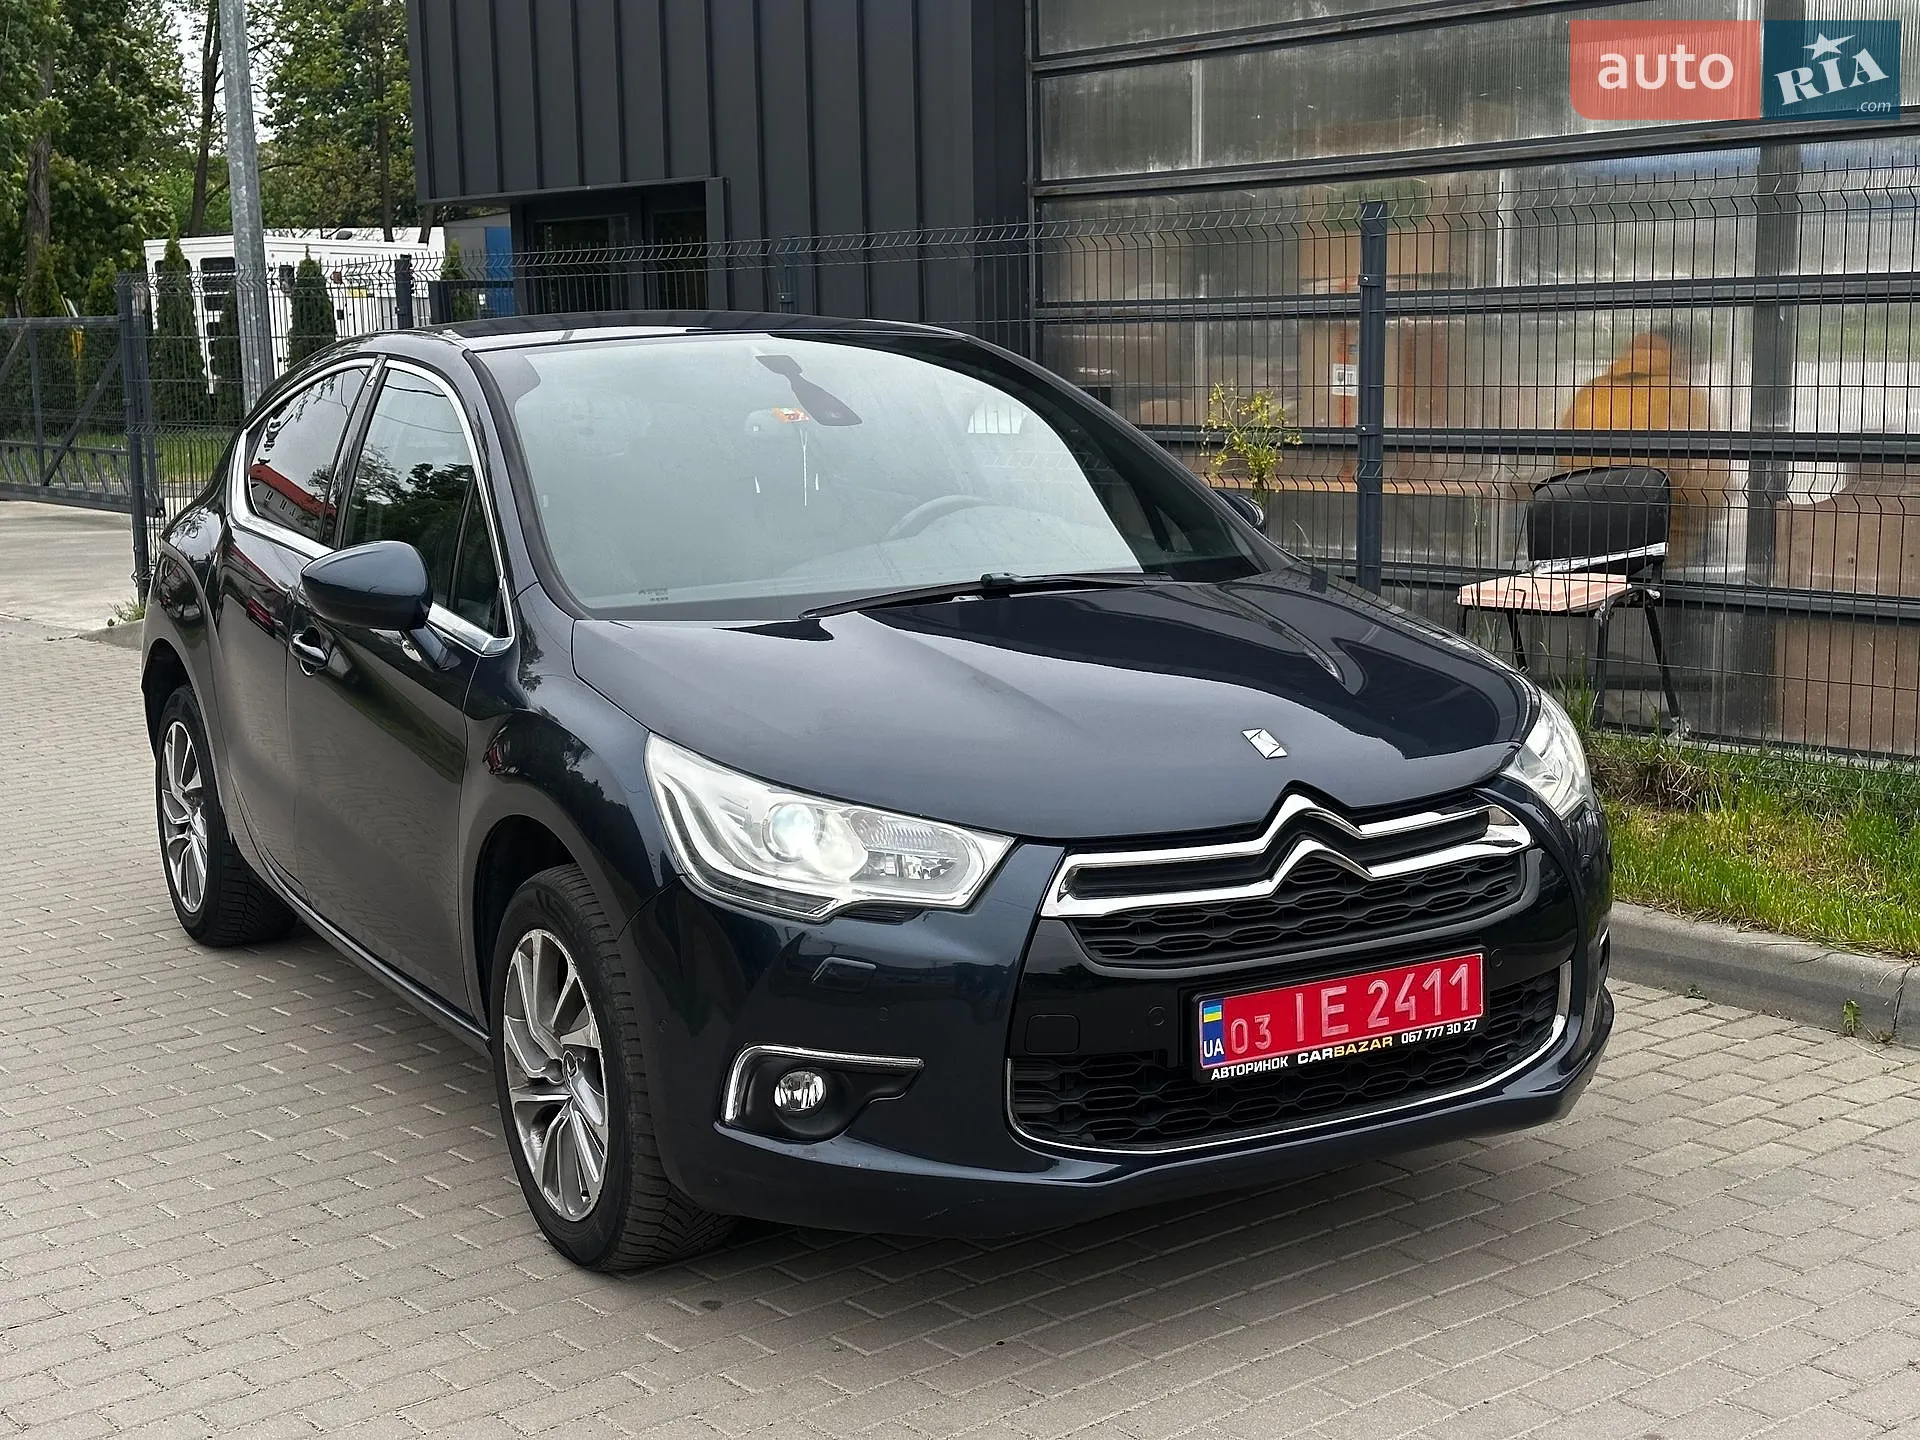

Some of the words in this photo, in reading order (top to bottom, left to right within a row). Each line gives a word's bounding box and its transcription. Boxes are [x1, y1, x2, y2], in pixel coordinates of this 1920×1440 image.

[1203, 1038, 1224, 1058] UA
[1231, 1014, 1271, 1055] 03
[1296, 986, 1349, 1042] IE
[1367, 963, 1469, 1029] 2411
[1401, 1031, 1423, 1044] 067
[1424, 1027, 1444, 1039] 777
[1446, 1023, 1462, 1035] 30
[1463, 1019, 1478, 1032] 27
[1297, 1036, 1393, 1064] CARBAZAR
[1211, 1057, 1288, 1080] АВТОРИНОК
